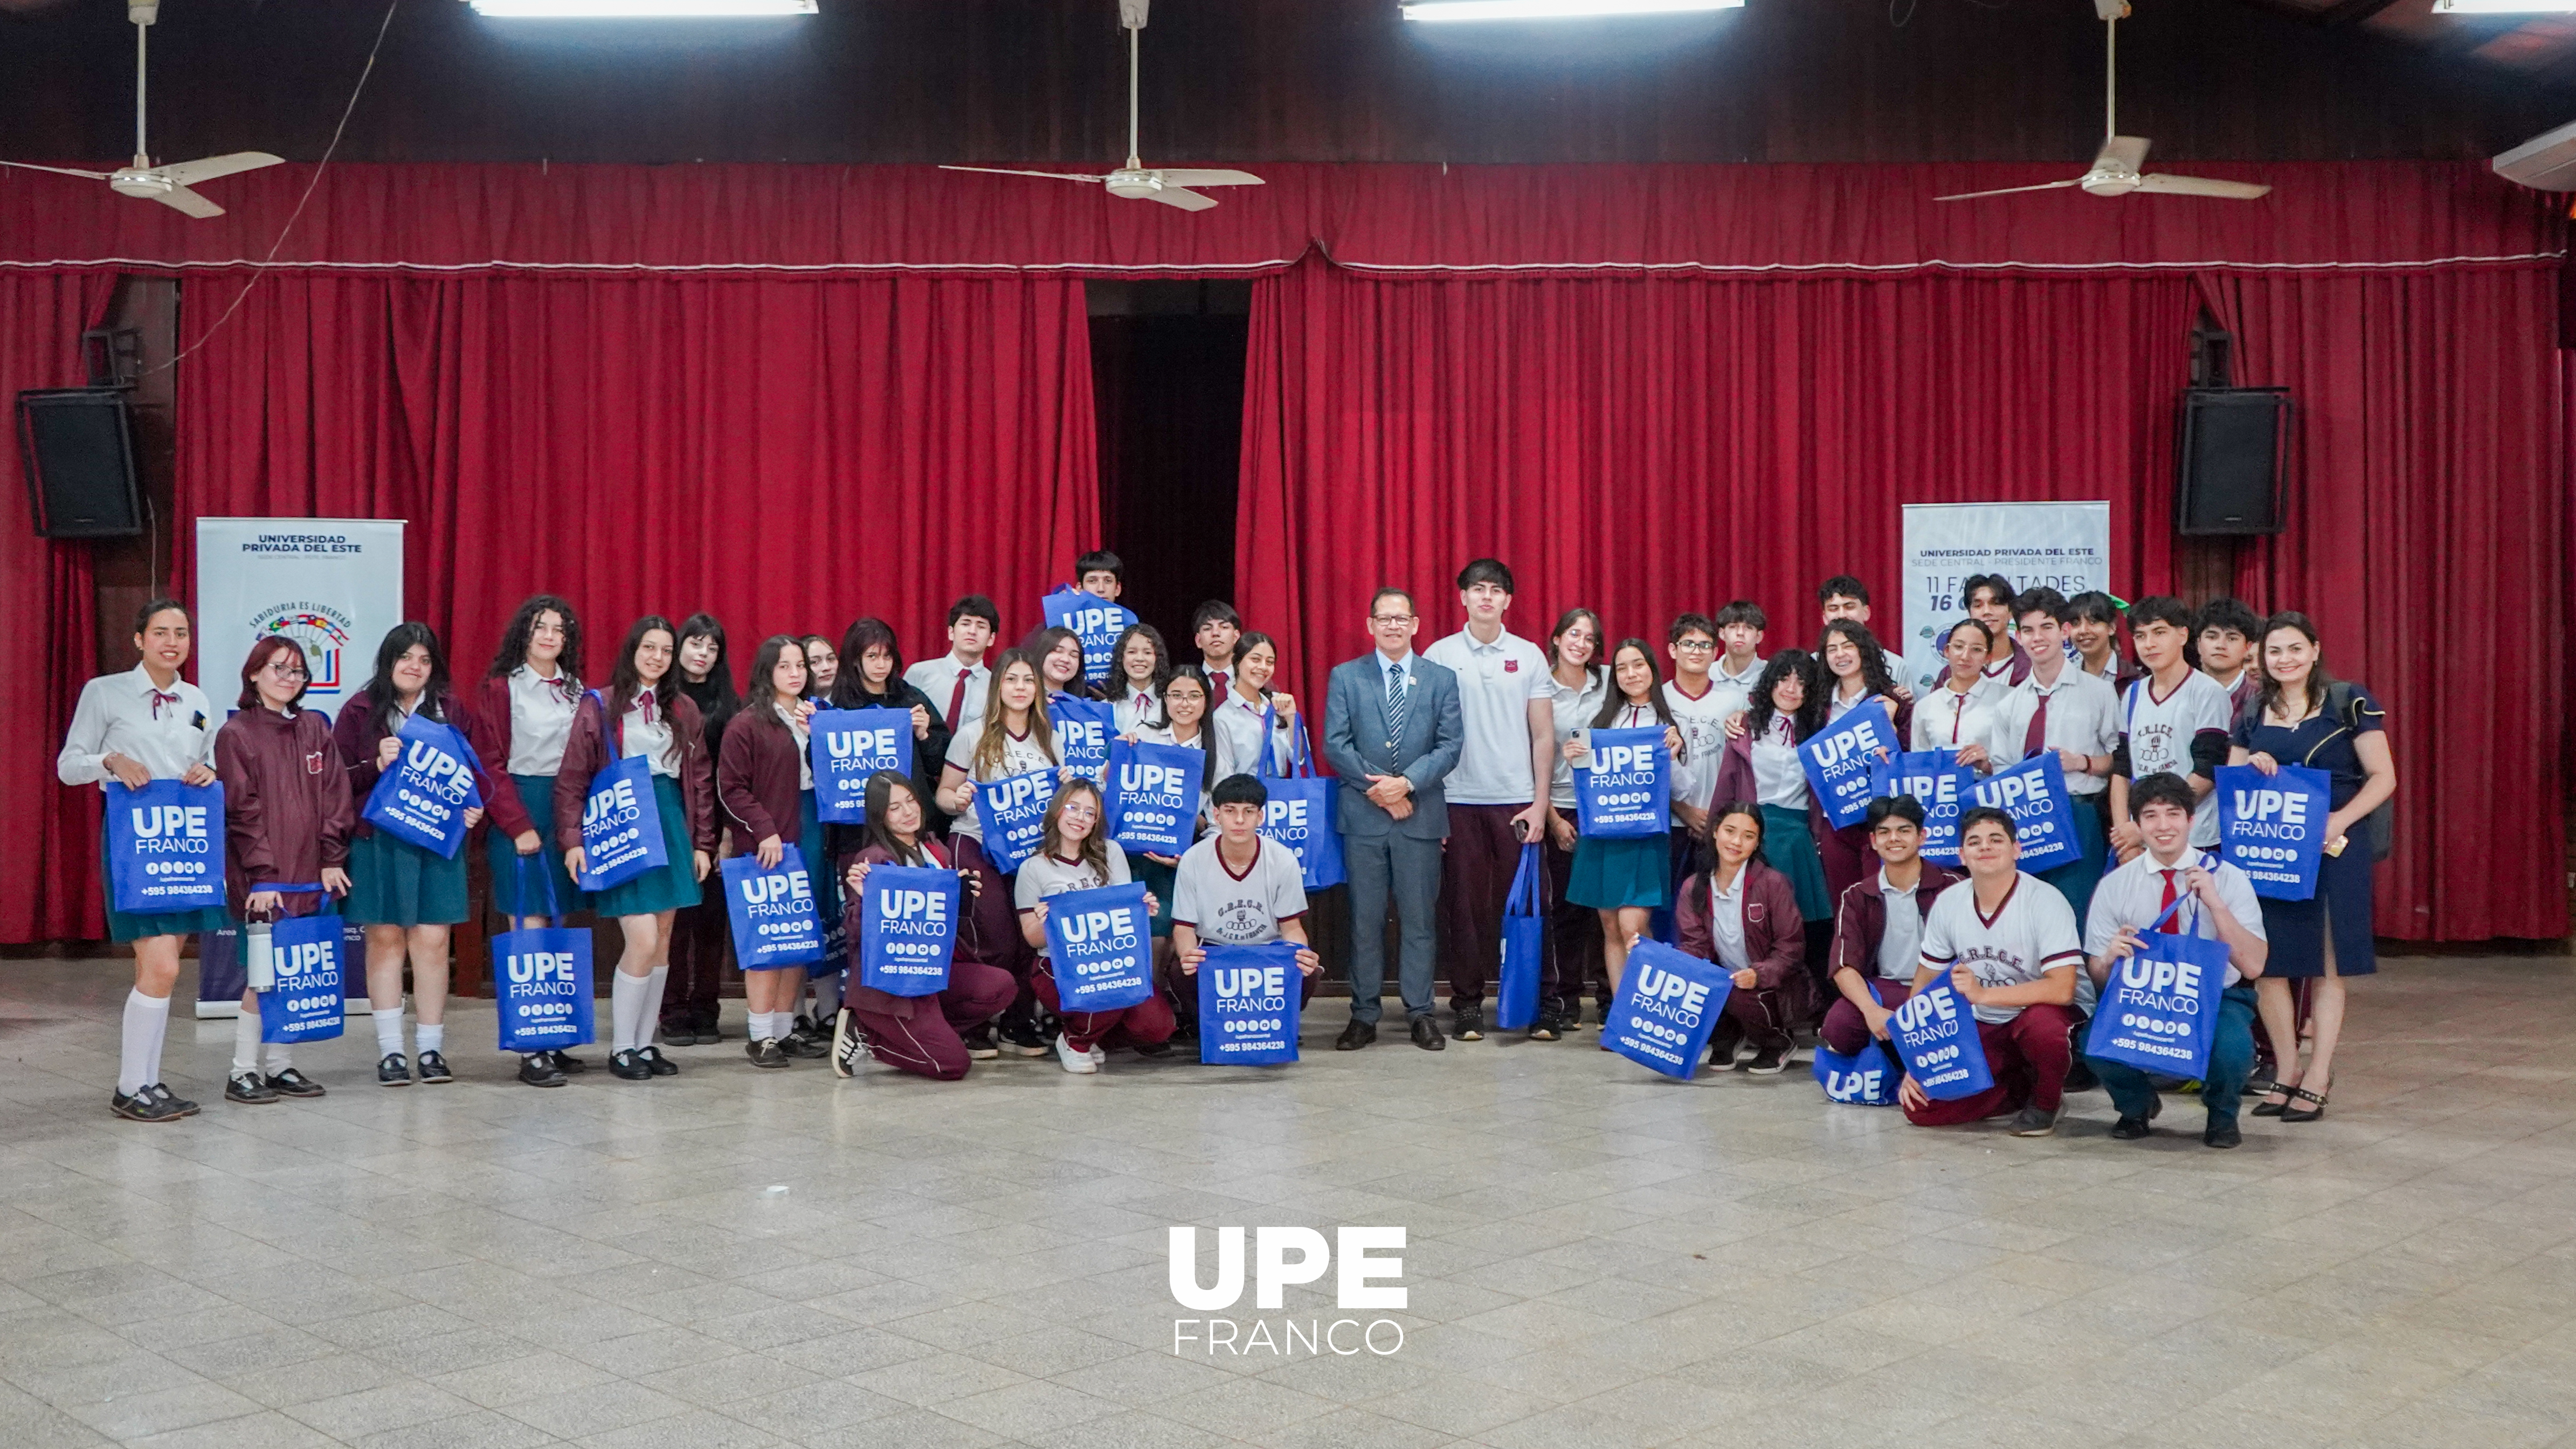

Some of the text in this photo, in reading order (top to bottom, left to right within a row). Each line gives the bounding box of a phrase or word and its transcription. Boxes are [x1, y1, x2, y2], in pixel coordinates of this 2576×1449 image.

[243, 544, 362, 553] PRIVADA DEL ESTE
[259, 535, 346, 543] UNIVERSIDAD
[1912, 559, 1937, 567] SEDE
[1940, 558, 1985, 567] CENTRAL
[1994, 557, 2056, 565] PRESIDENTE
[2060, 557, 2102, 565] FRANCO
[1926, 575, 2085, 593] 11 FATADES
[1931, 595, 1952, 611] 16
[249, 602, 351, 628] SABIDURIA ES LIBERTAD
[1063, 608, 1124, 636] UPE
[1078, 633, 1122, 647] RANC
[1690, 715, 1719, 730] E.C.E.
[827, 729, 896, 758] UPE
[1065, 746, 1104, 759] ANCO
[1812, 720, 1880, 768] UPE
[407, 739, 475, 798] UPE
[831, 755, 899, 772] FRANCO
[1590, 744, 1654, 775] UPE
[399, 764, 463, 805] FRANCO
[1119, 763, 1185, 796] UPE
[1590, 771, 1655, 789] FRANCO
[1889, 774, 1958, 804] UPE
[1976, 768, 2049, 809] UPE
[987, 771, 1053, 811] UPE
[1119, 791, 1183, 809] FRANCO
[583, 778, 637, 826] UPE
[834, 801, 854, 809] +595
[2007, 798, 2054, 820] ANCO
[132, 805, 208, 838] UPE
[385, 806, 404, 820] +595
[583, 806, 640, 838] FRANCO
[1594, 812, 1656, 824] +595 984364238
[1117, 831, 1177, 844] +595 984364238
[1255, 827, 1309, 840] RANCO
[2232, 820, 2305, 841] FRANCO
[135, 838, 209, 854] FRANCO
[1009, 849, 1027, 859] +595
[741, 871, 811, 903] UPE
[2253, 871, 2300, 884] 984364238
[141, 885, 213, 896] +595 984364238
[747, 898, 814, 919] FRANCO
[880, 889, 946, 922] UPE
[217, 928, 237, 936] Area
[880, 919, 947, 936] FRANCO
[1061, 908, 1135, 943] UPE
[757, 940, 818, 954] +595 984364238
[1066, 935, 1137, 958] FRANCO
[274, 941, 336, 977] UPE
[507, 952, 575, 983] UPE
[879, 965, 943, 975] +595 984364238
[2122, 957, 2202, 999] UPE
[278, 971, 339, 992] FRANCO
[510, 981, 576, 998] FRANCO
[1075, 977, 1142, 994] +595 984364238
[1214, 967, 1285, 998] UPE
[1638, 964, 1710, 1015] UPE
[1217, 996, 1286, 1013] FRANCO
[1631, 993, 1700, 1029] FRANCO
[1896, 986, 1957, 1032] UPE
[2119, 988, 2199, 1016] FRANCO
[515, 1026, 536, 1036] +595
[1903, 1019, 1958, 1048] FRANCO
[1219, 1040, 1285, 1052] +595 984364238
[1620, 1035, 1640, 1049] +595
[1640, 1043, 1684, 1065] 984364238
[2112, 1037, 2193, 1060] +595 984364238
[1827, 1070, 1882, 1101] UPE
